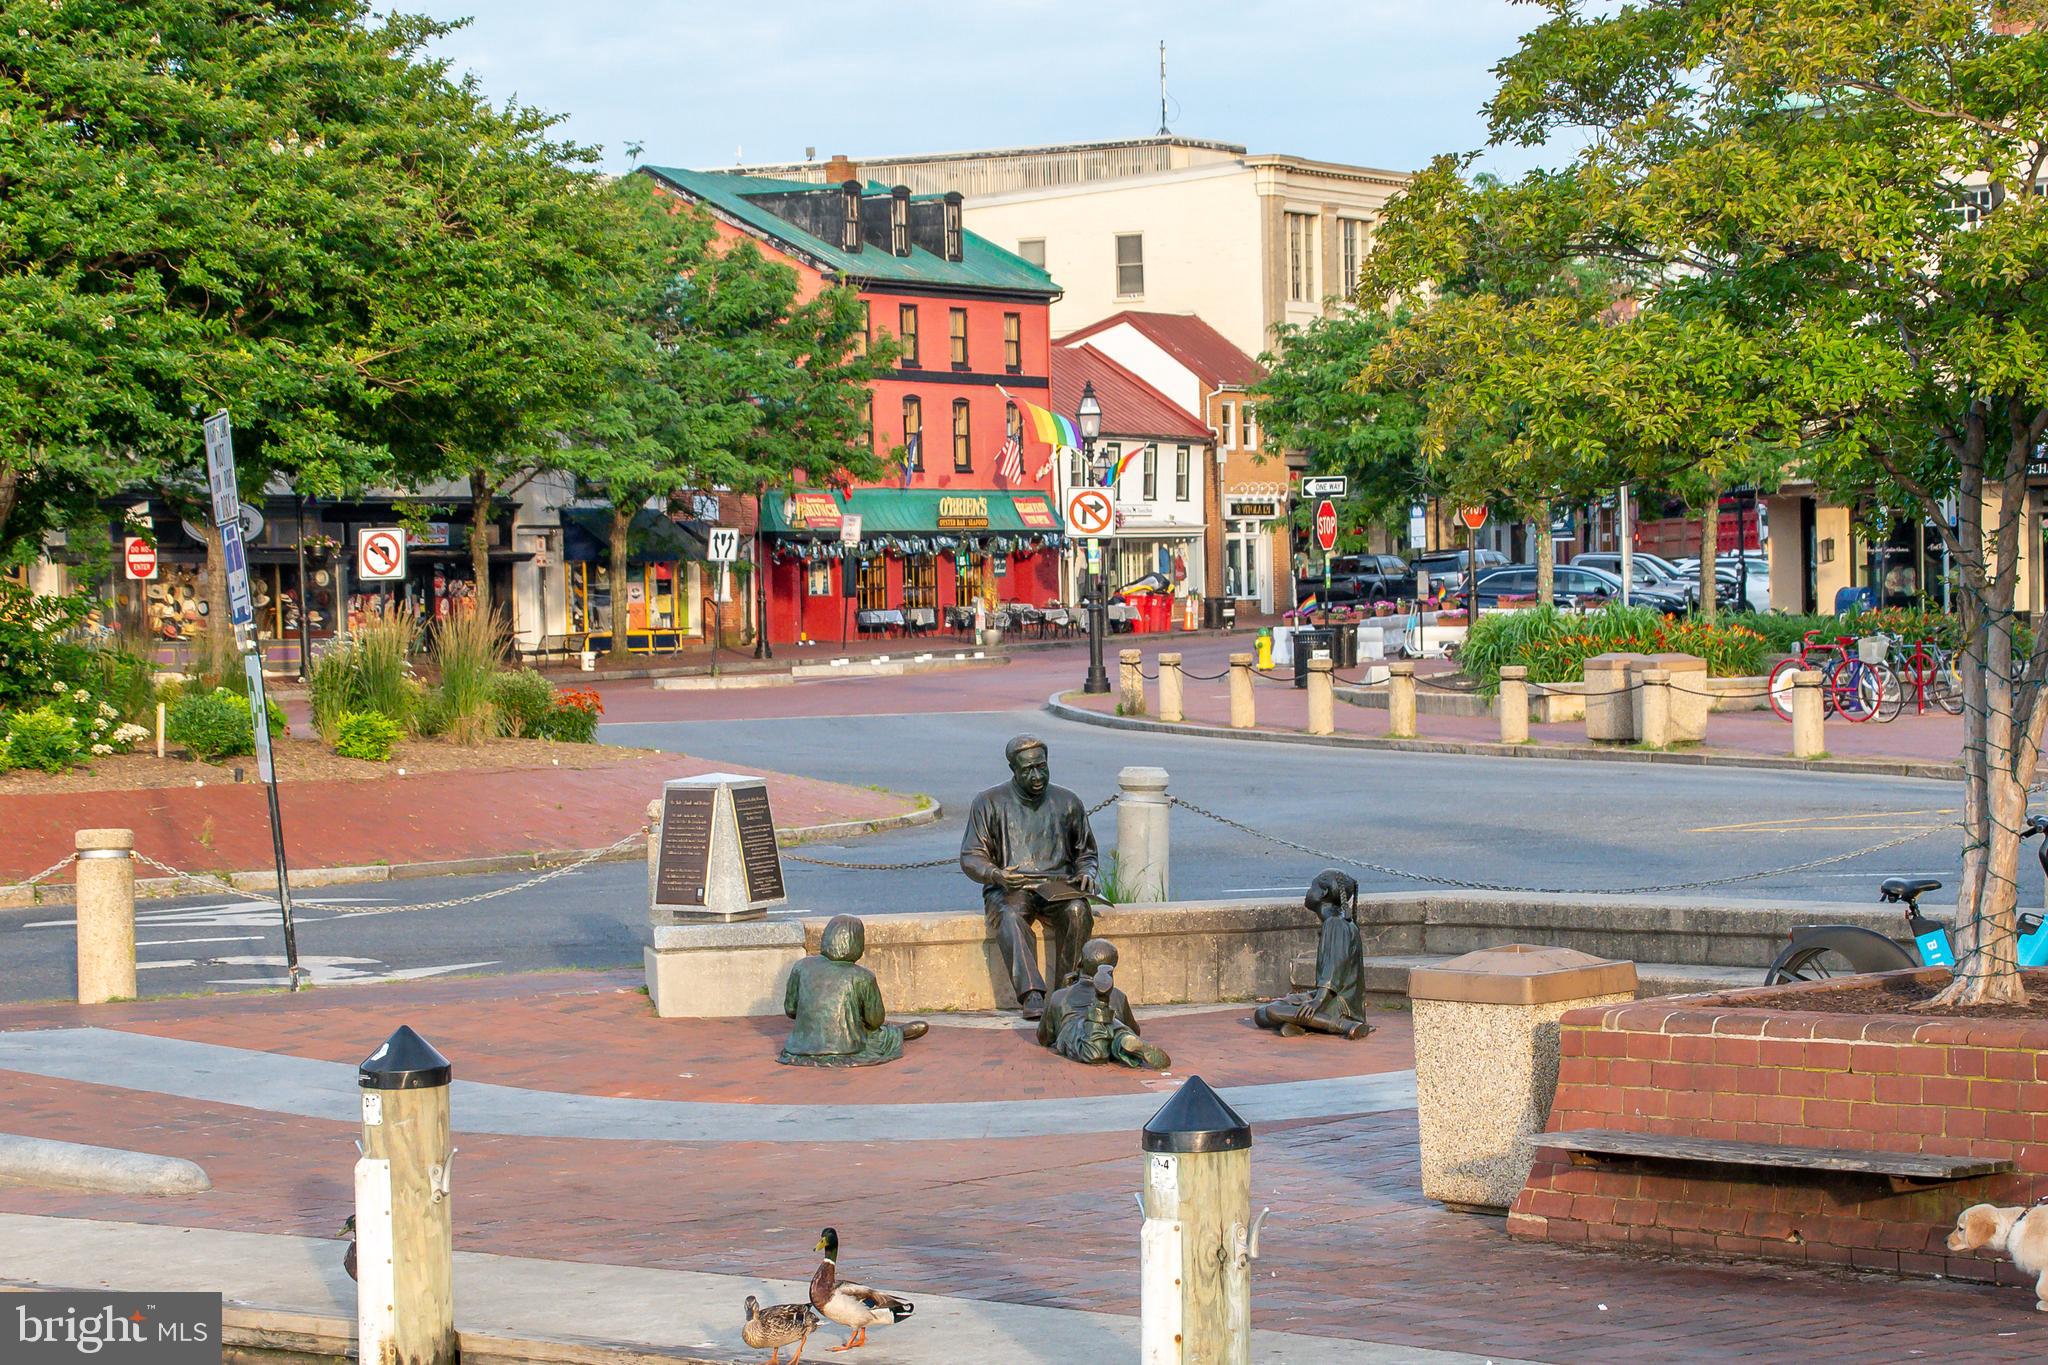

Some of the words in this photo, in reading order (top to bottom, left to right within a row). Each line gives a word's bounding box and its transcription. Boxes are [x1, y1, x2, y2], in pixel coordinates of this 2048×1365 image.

[213, 442, 226, 468] MUST
[1315, 483, 1328, 491] ONE
[1329, 482, 1341, 490] WAY
[939, 496, 988, 517] O'BRIEN'S
[1319, 516, 1336, 535] STOP
[133, 563, 151, 571] ENTER
